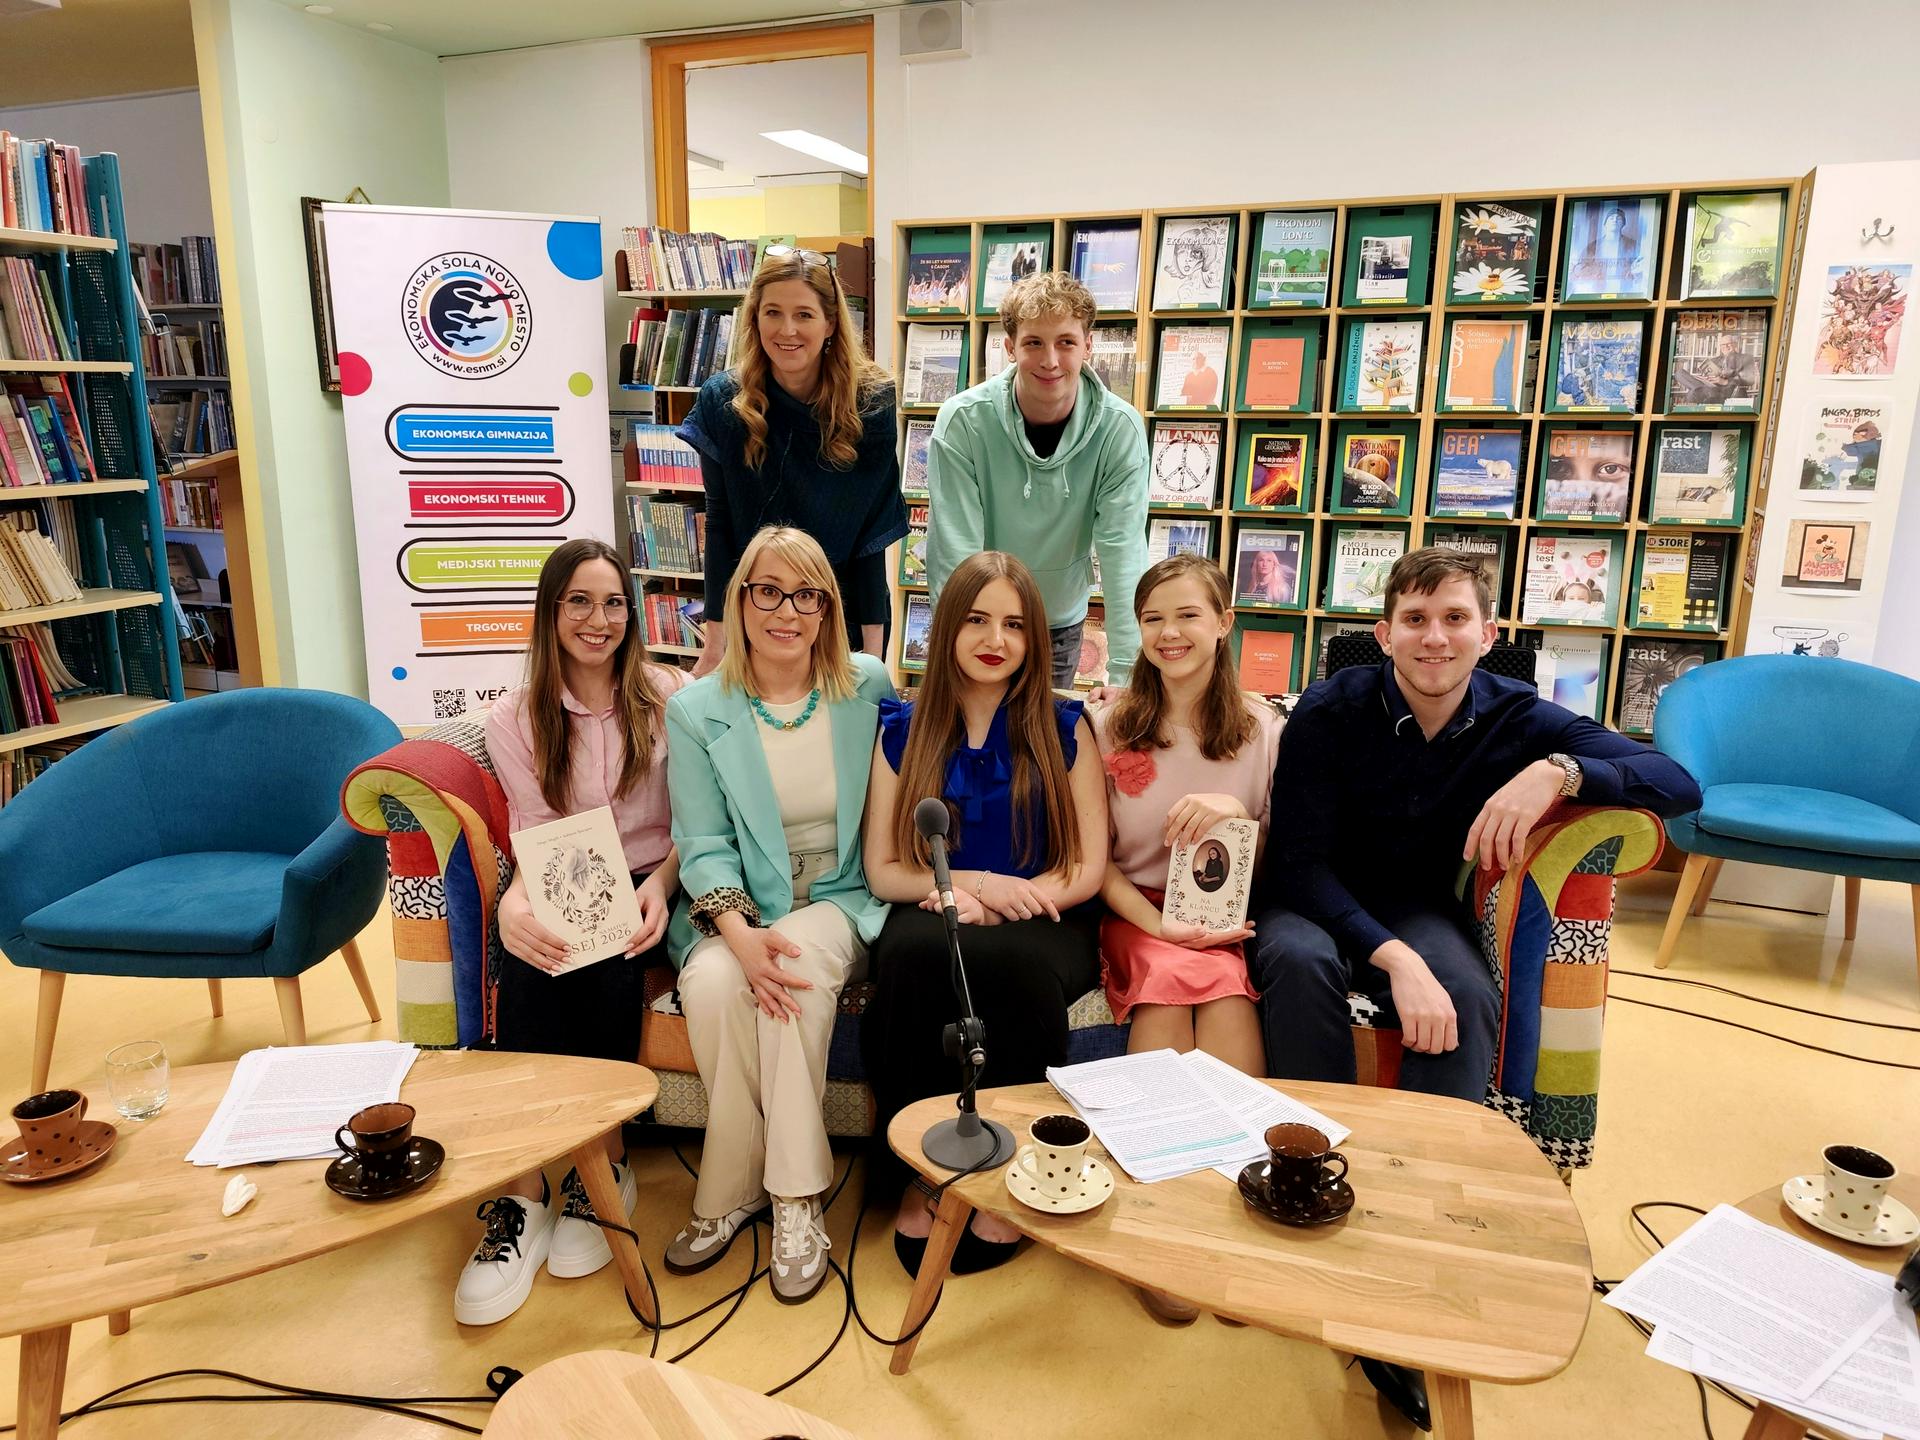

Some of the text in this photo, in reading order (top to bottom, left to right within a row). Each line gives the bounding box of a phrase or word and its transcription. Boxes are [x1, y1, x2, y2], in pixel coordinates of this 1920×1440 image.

[1274, 218, 1322, 228] EKONOM
[1166, 237, 1201, 246] EKONOM
[407, 256, 527, 352] EKONOMSKA ŠOLA NOVO MESTO
[1352, 327, 1361, 366] KNJIŽNICA
[432, 353, 507, 374] www.esnm.si
[1821, 407, 1880, 418] ANGRY BIRDS
[413, 429, 548, 440] EKONOMSKA GIMNAZIJA
[1154, 429, 1219, 444] MLADINA
[1444, 434, 1479, 456] GEA
[1551, 436, 1589, 457] GEA
[1661, 435, 1701, 449] rast
[1351, 449, 1398, 457] GEOGRAPHIC
[424, 494, 546, 504] EKONOMSKI TEHNIK
[1658, 538, 1689, 547] STORE
[1341, 545, 1397, 557] finance
[1536, 545, 1555, 554] ZPS
[1536, 554, 1555, 562] test
[437, 559, 542, 570] MEDIJSKI TEHNIK
[465, 622, 524, 632] TRGOVEC
[1628, 648, 1667, 662] rast
[570, 927, 631, 956] SEJ 2026
